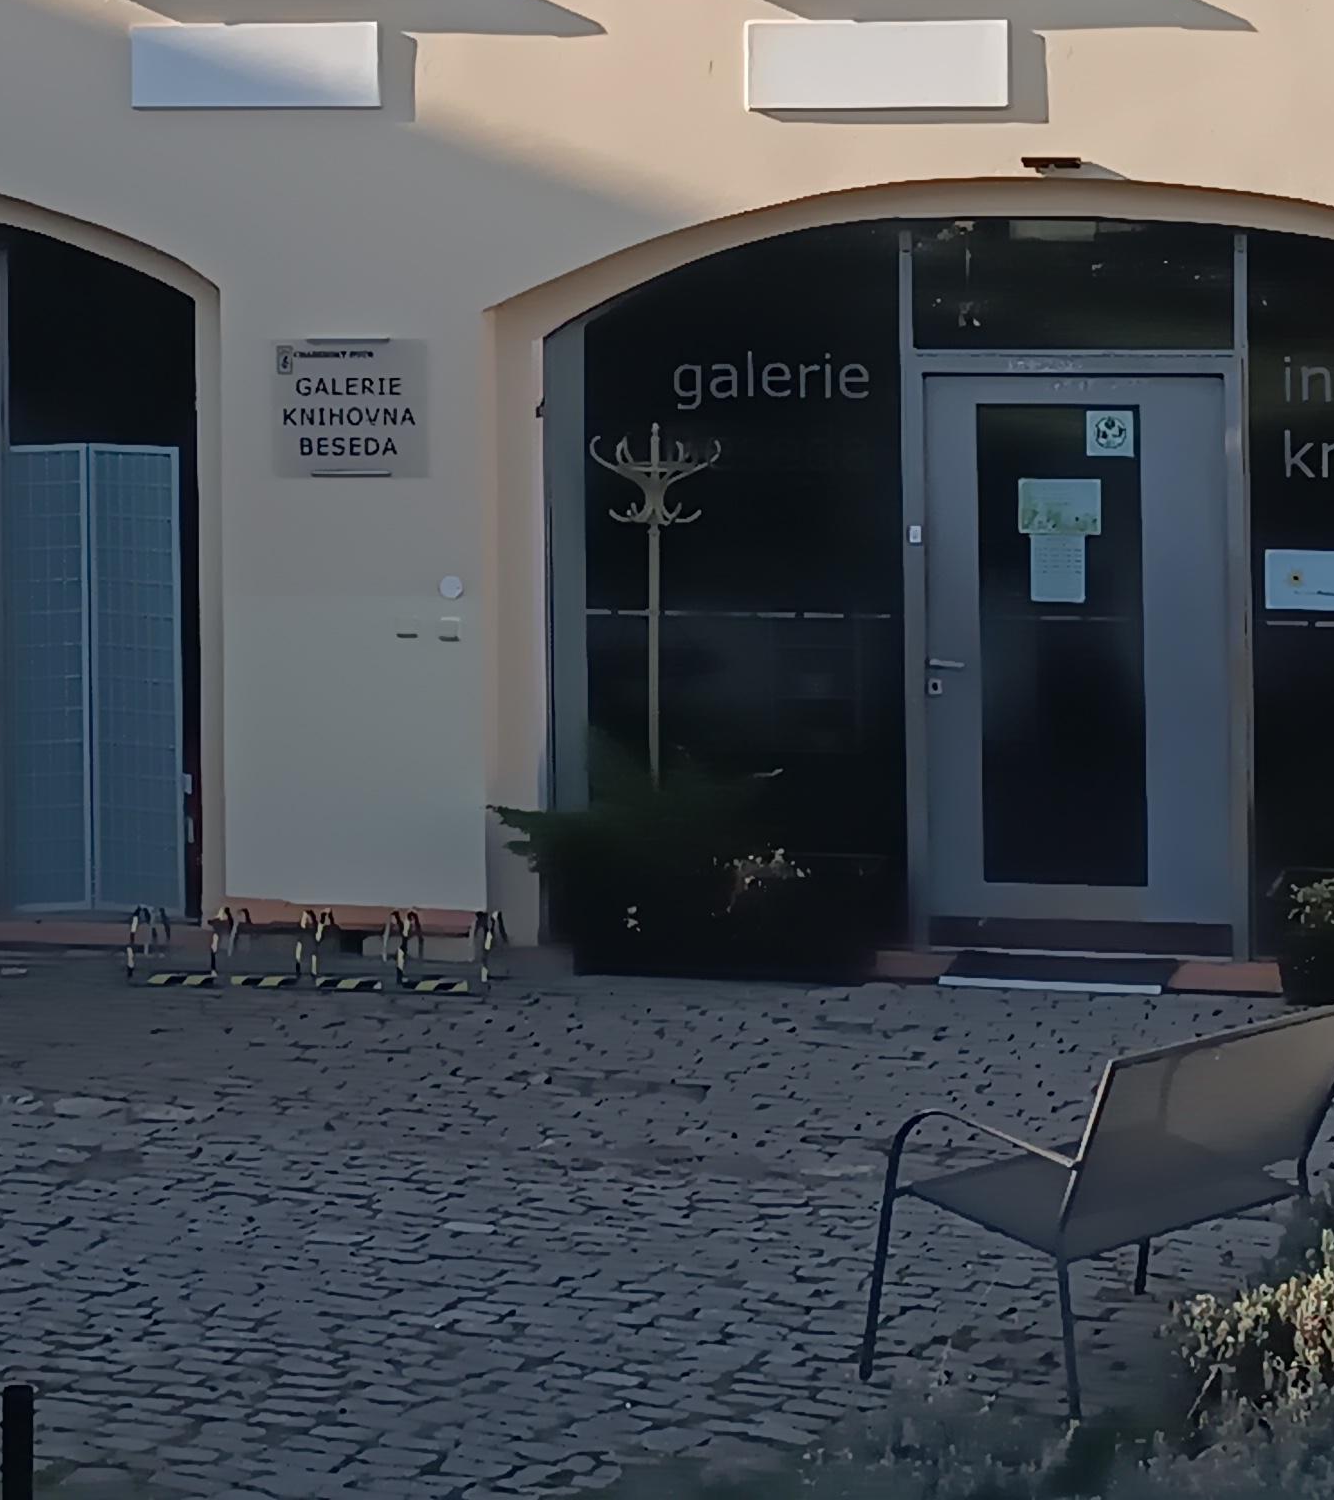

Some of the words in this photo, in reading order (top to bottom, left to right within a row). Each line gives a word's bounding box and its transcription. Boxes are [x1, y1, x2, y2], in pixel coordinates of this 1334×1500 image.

[295, 377, 402, 397] GALERIE
[673, 350, 870, 410] galerie
[282, 406, 416, 426] KNIHOVNA
[299, 437, 398, 456] BESEDA
